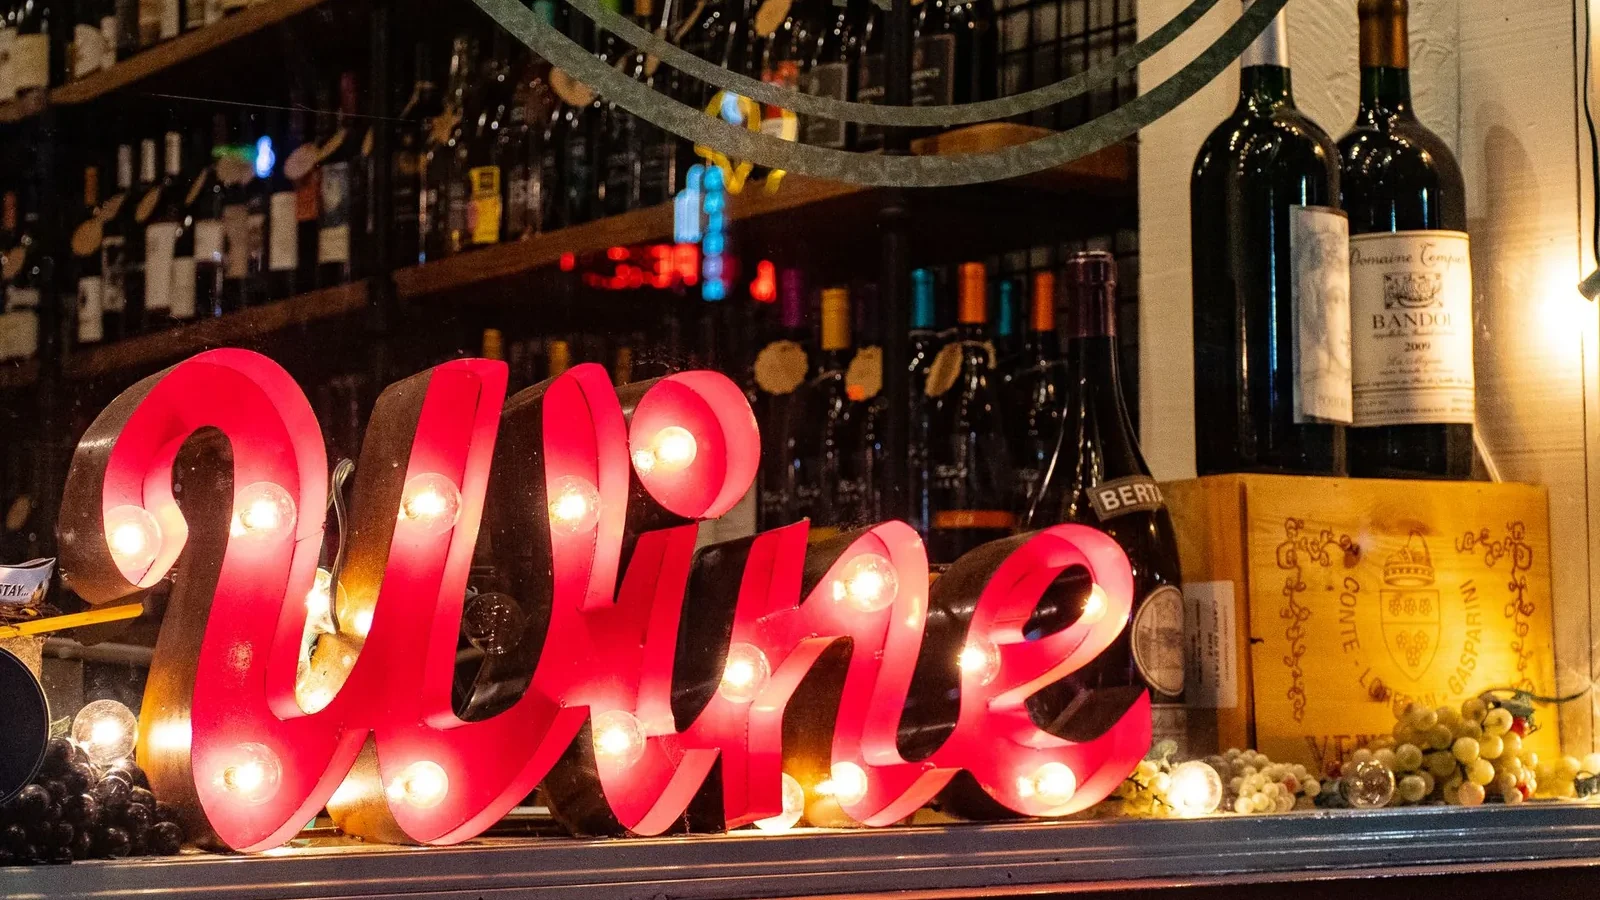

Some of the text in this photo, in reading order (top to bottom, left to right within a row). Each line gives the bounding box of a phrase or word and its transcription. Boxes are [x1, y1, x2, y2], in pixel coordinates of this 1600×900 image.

[1404, 341, 1431, 353] 2009
[60, 347, 1153, 853] Wine
[1338, 576, 1360, 653] CONTE
[1448, 578, 1483, 696] GASPARINI
